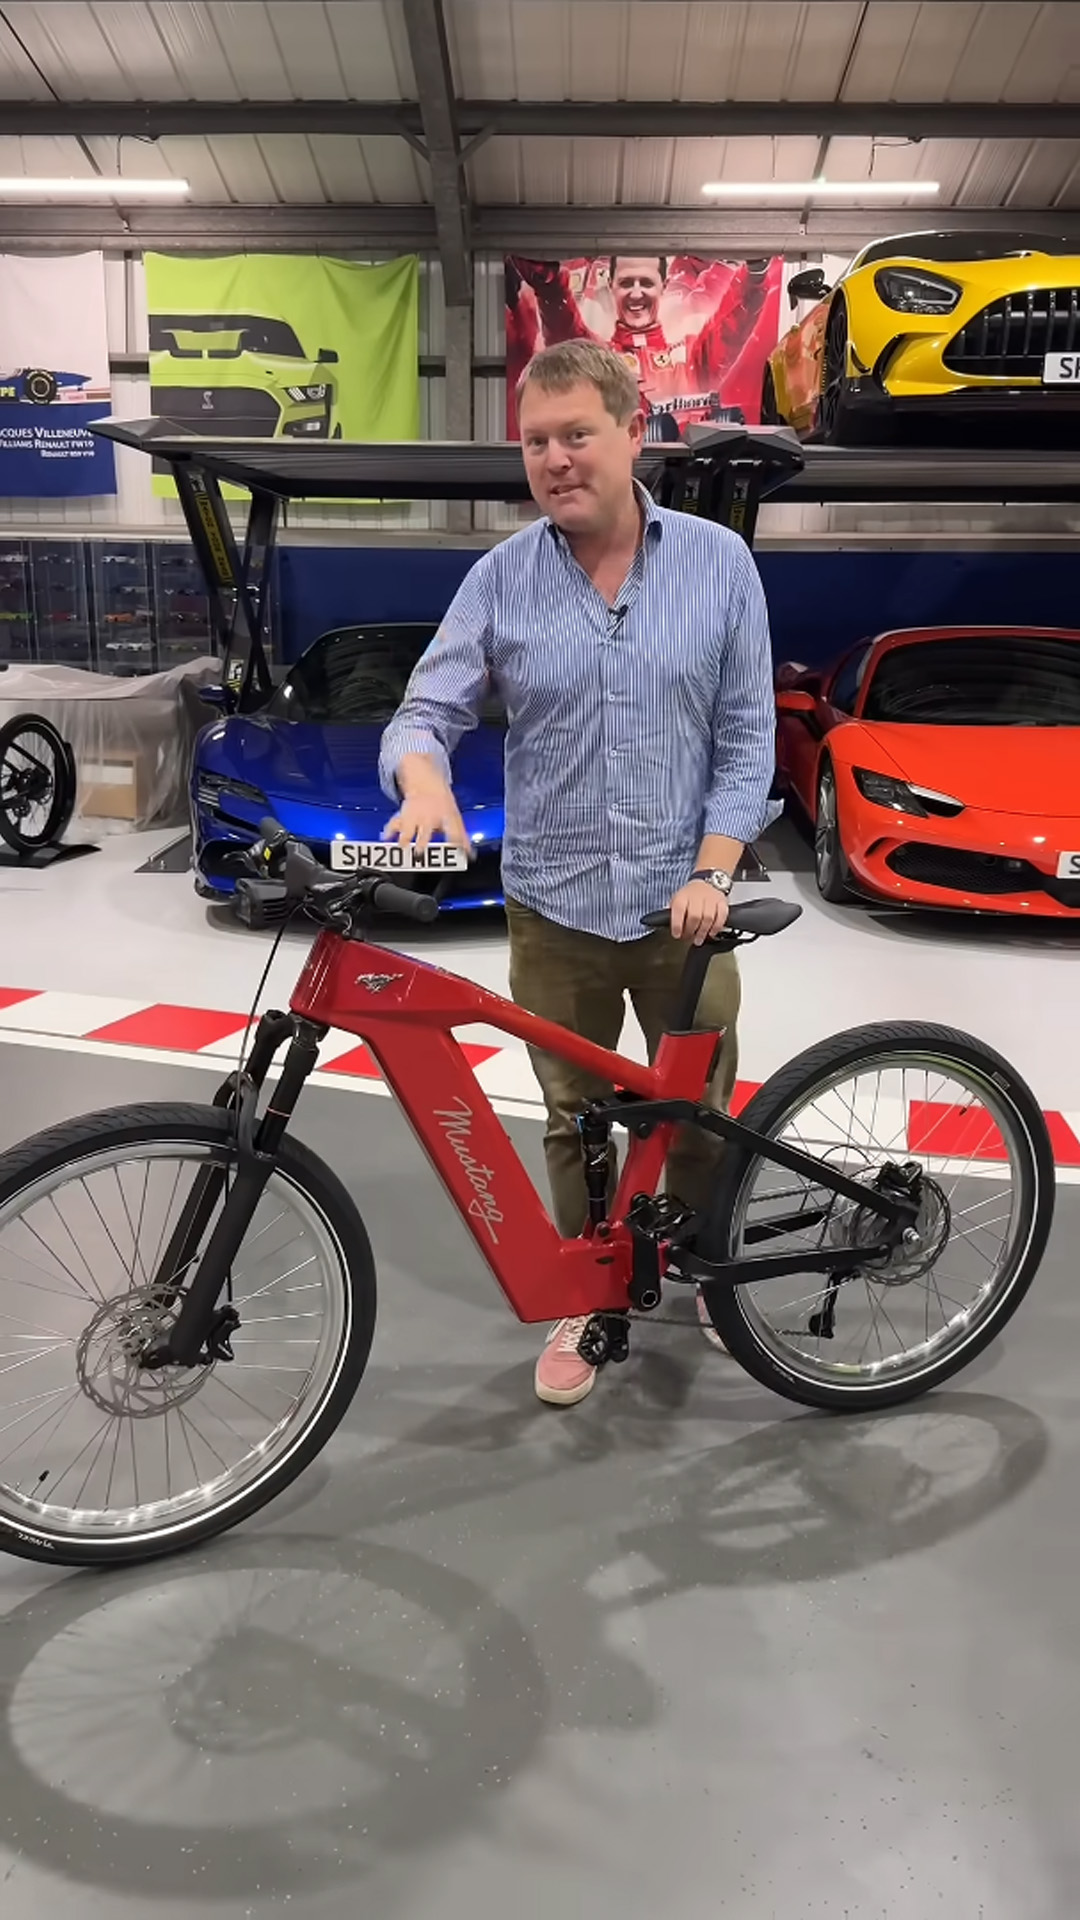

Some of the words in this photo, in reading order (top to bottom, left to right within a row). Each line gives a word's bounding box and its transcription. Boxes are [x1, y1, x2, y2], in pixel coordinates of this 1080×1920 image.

[0, 428, 33, 439] CQUES
[342, 845, 403, 867] SH20
[433, 1096, 503, 1244] Mustang
